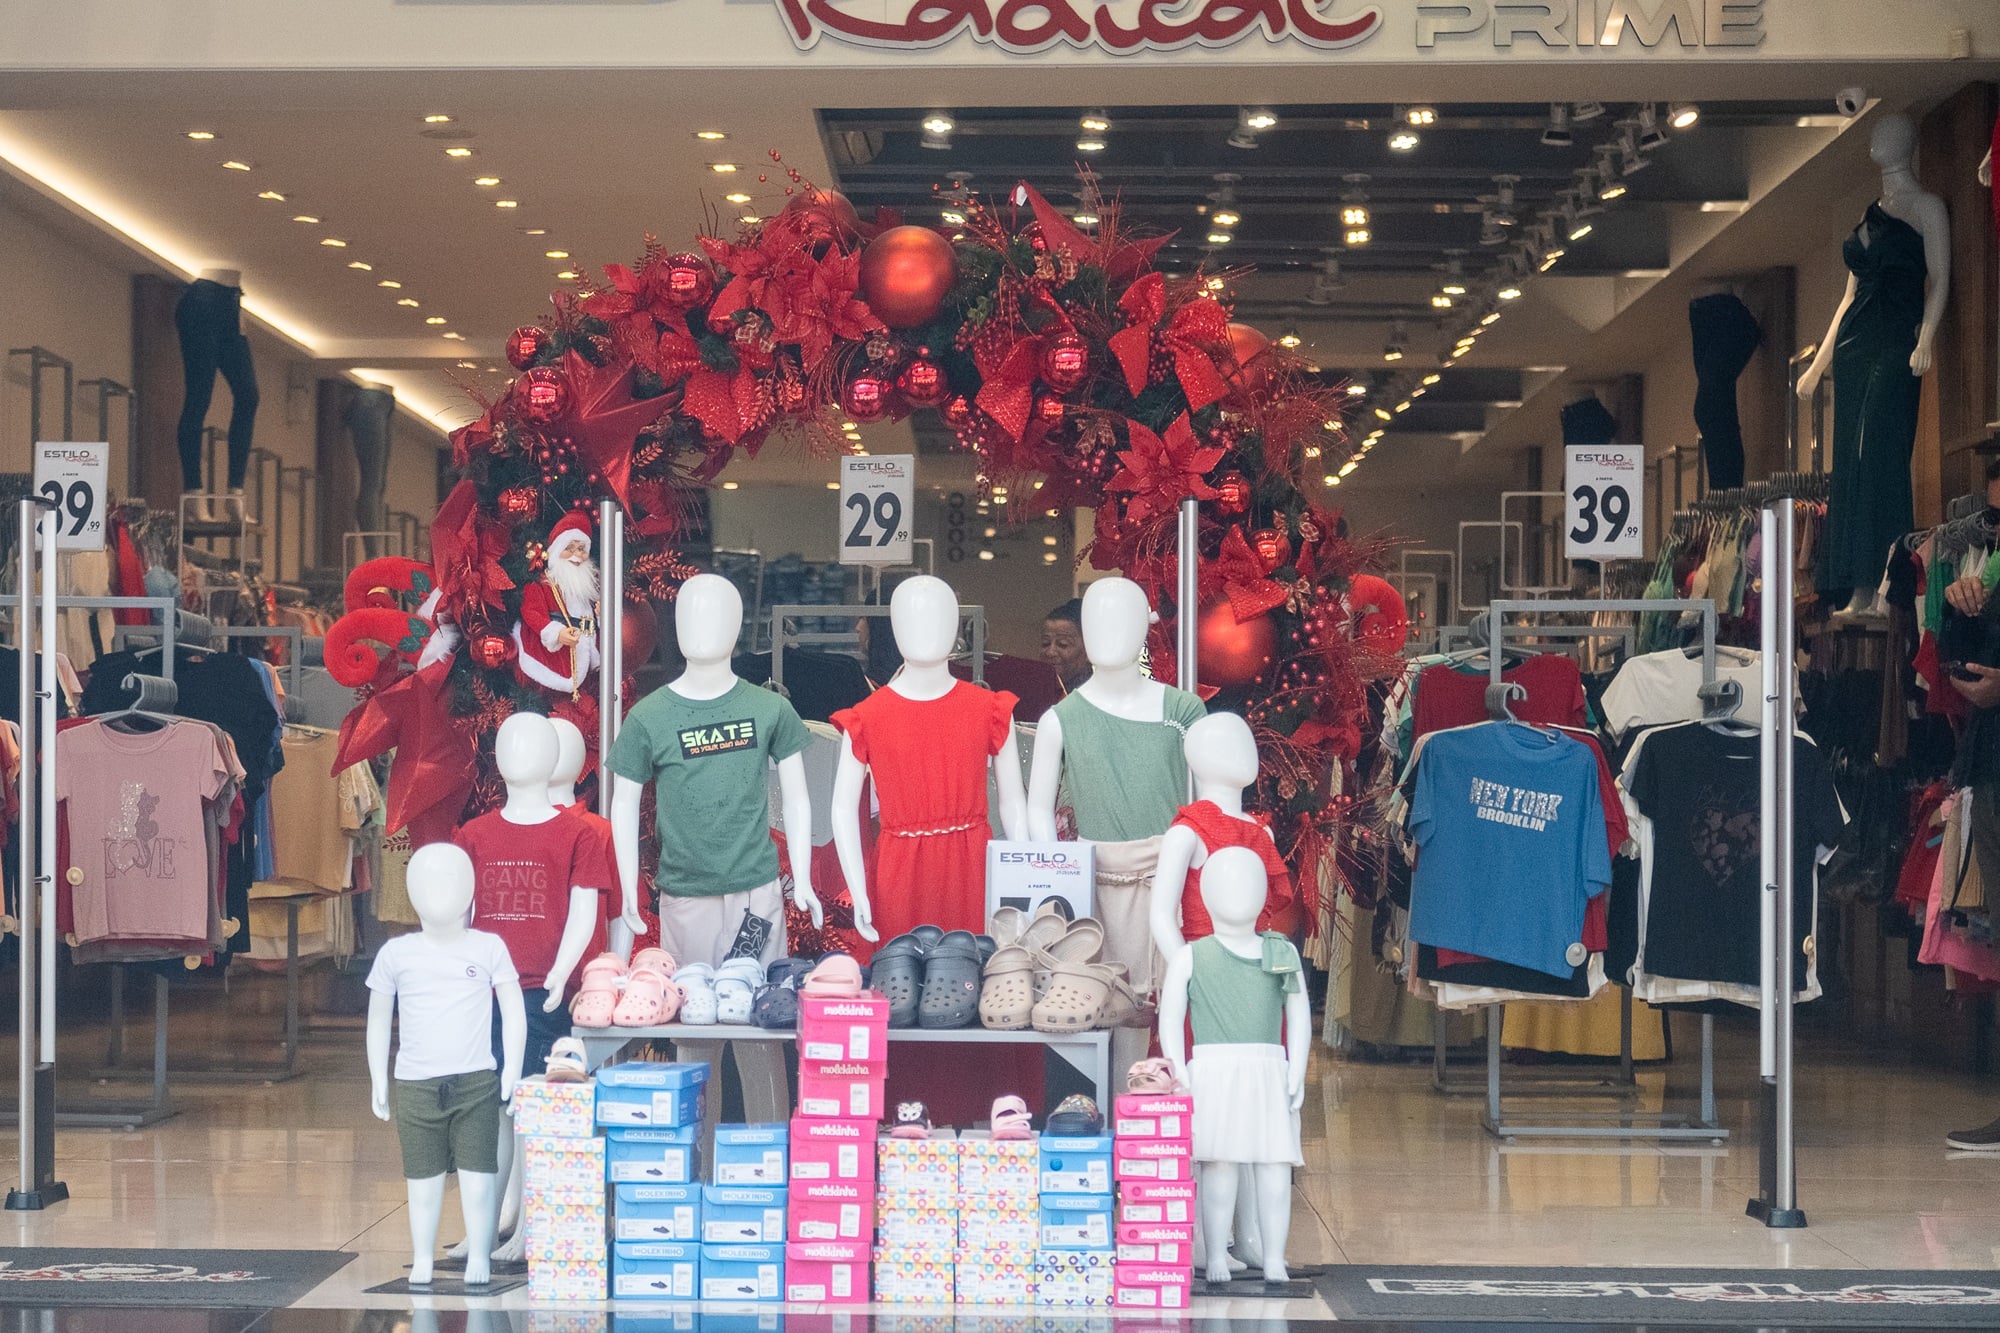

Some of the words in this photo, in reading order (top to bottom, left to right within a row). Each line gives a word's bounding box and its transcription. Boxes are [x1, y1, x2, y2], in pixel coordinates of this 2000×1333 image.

[1416, 0, 1766, 47] PRIME
[44, 450, 90, 458] ESTILO
[1575, 453, 1625, 462] ESTILO
[849, 463, 895, 471] ESTILO
[845, 492, 902, 547] 29
[1570, 485, 1630, 544] 39
[681, 722, 754, 748] SKATE
[1470, 777, 1509, 809] NEW
[1511, 788, 1563, 821] YORK
[1477, 806, 1546, 832] BROOKLIN
[1000, 852, 1067, 863] ESTILO
[482, 867, 547, 890] GANG
[481, 891, 546, 913] STER
